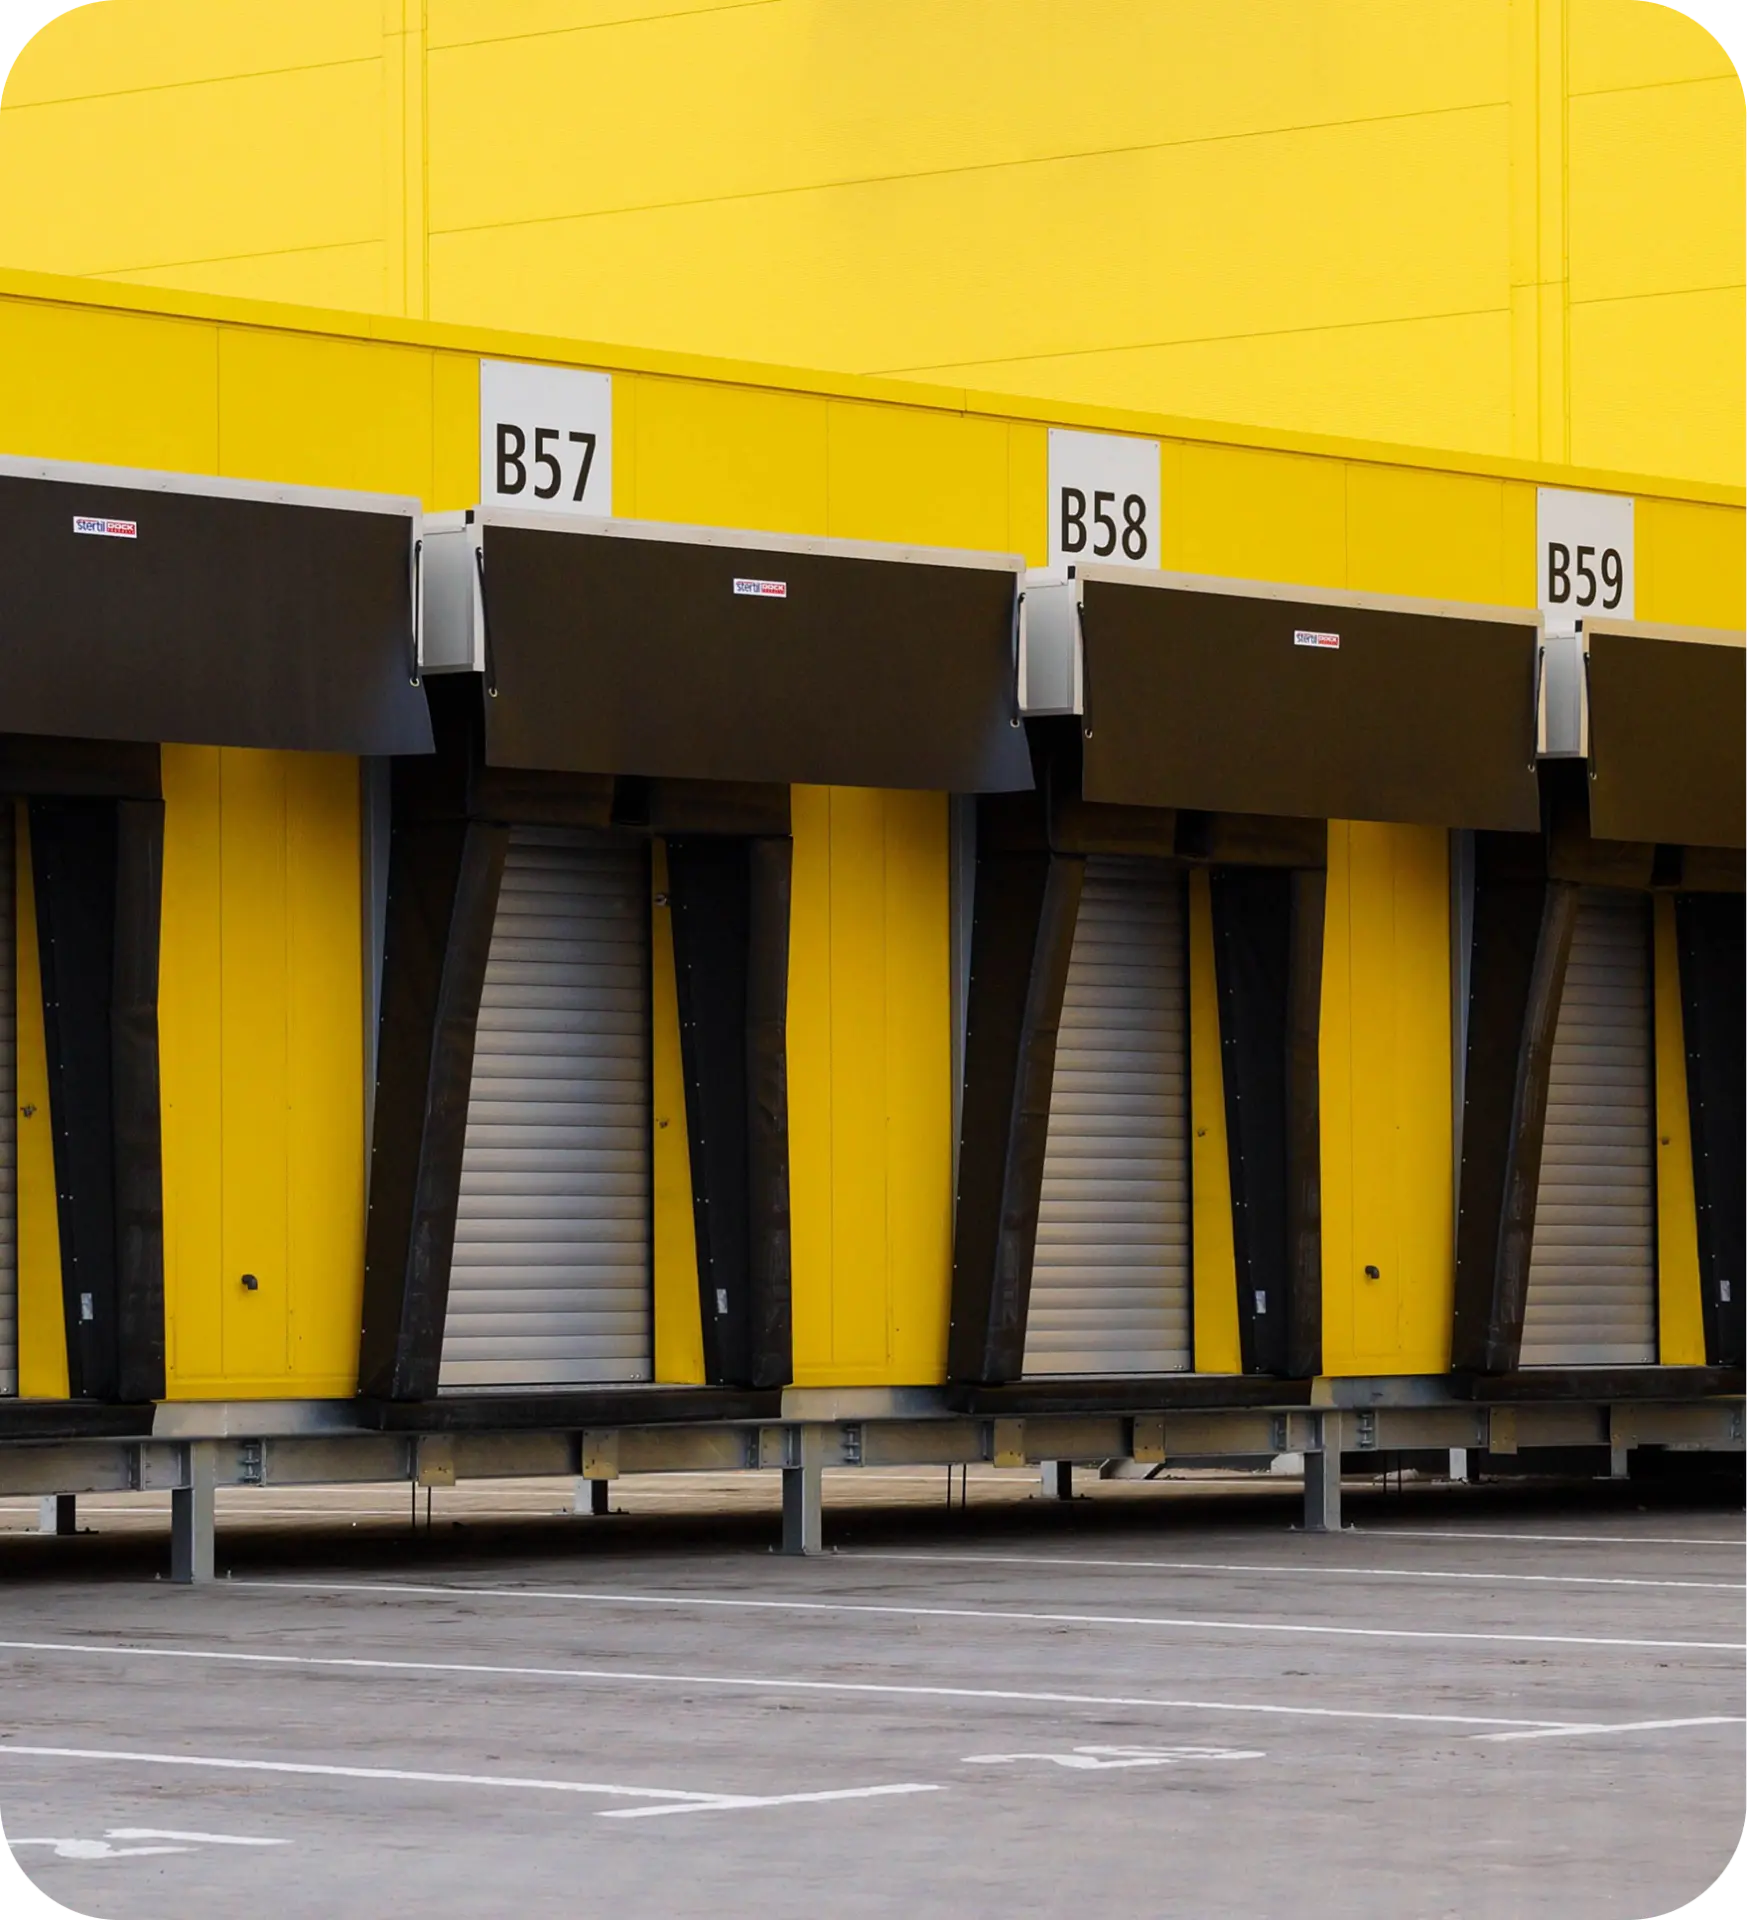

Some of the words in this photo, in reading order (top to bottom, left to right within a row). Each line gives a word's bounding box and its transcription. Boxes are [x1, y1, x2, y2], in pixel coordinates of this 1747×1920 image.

[496, 423, 597, 502] B57
[76, 519, 106, 533] stertil
[1061, 486, 1148, 561] B58
[1548, 542, 1624, 610] B59
